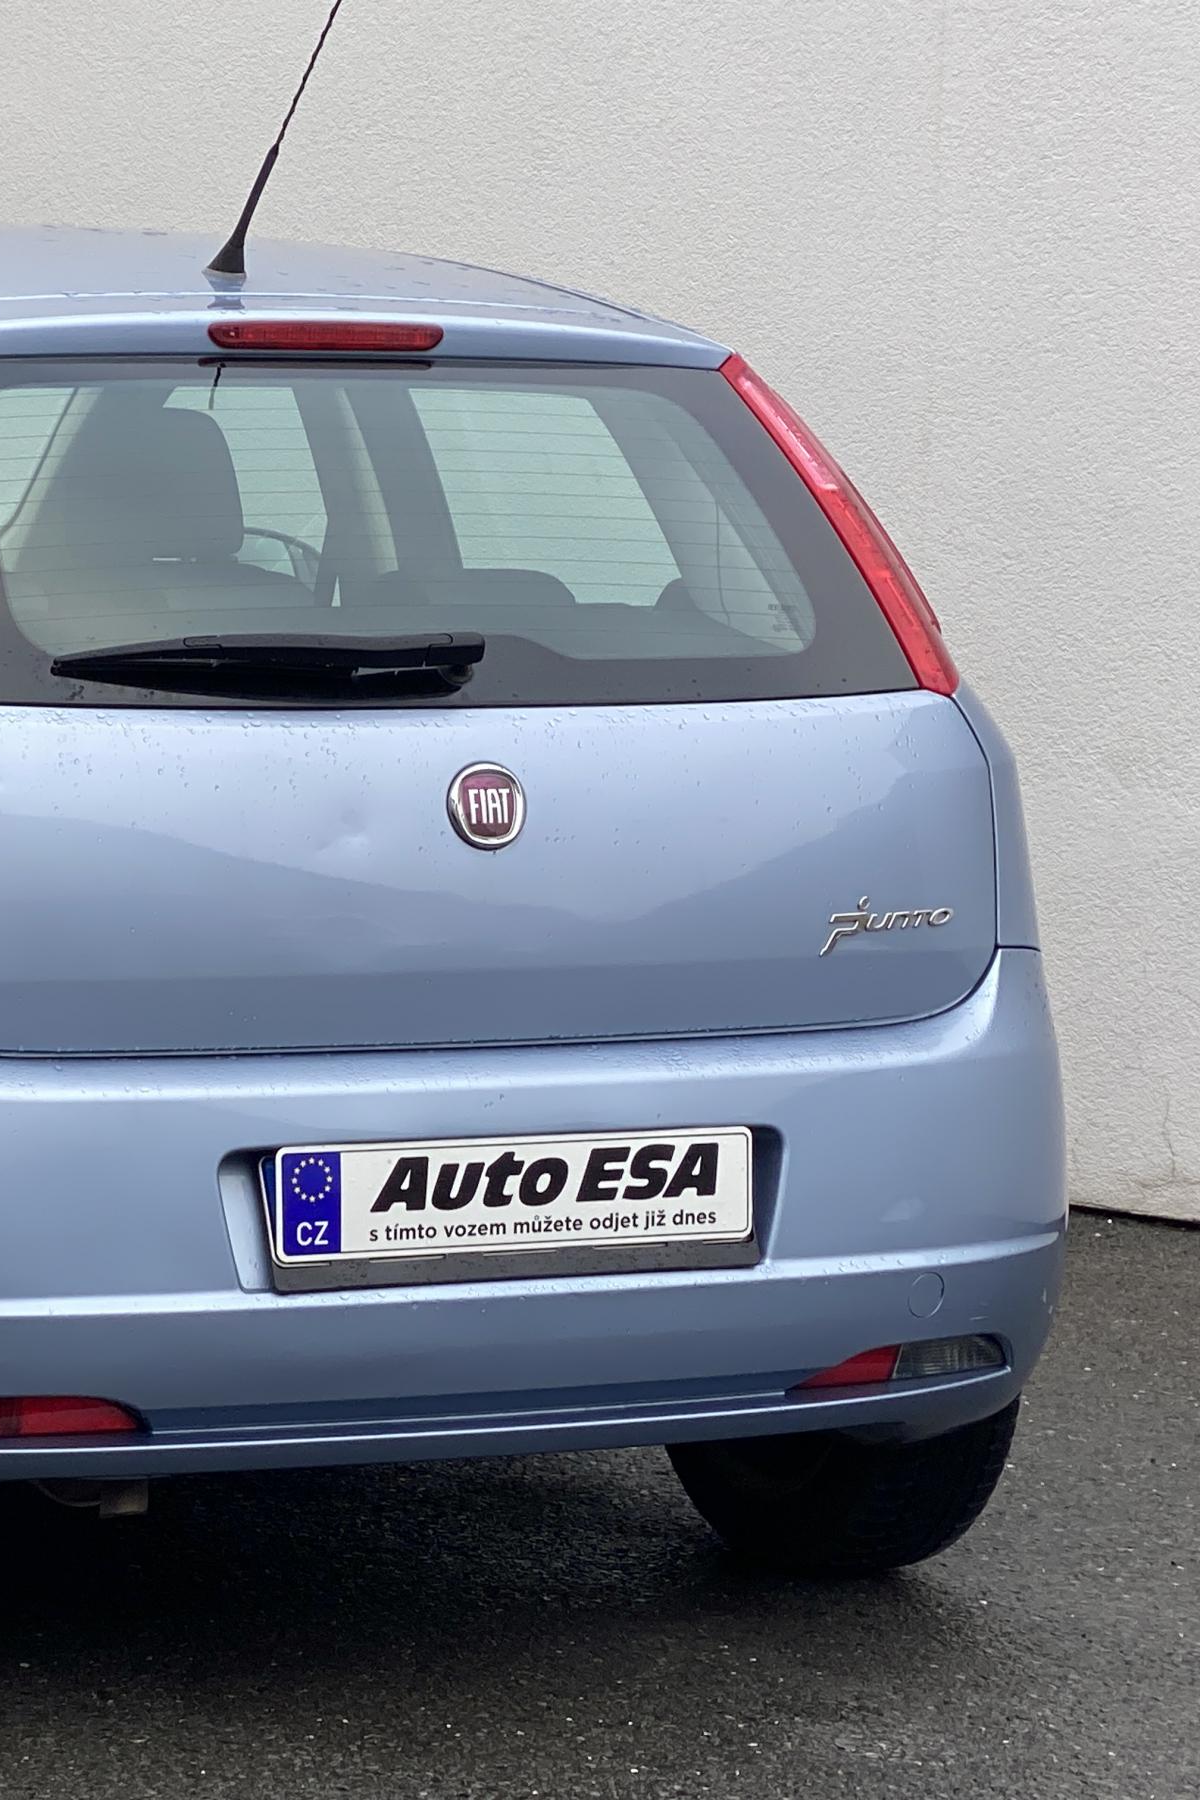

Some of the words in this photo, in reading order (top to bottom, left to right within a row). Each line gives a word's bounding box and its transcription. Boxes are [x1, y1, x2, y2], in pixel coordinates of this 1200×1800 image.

[468, 788, 510, 824] FIAT
[370, 1151, 568, 1213] Auto
[576, 1142, 720, 1202] ESA
[296, 1221, 330, 1246] CZ
[369, 1229, 379, 1242] s
[385, 1223, 438, 1241] tímto
[444, 1222, 507, 1238] vozem
[513, 1215, 583, 1235] můžete
[589, 1212, 639, 1232] odjet
[644, 1209, 667, 1230] již
[672, 1209, 718, 1226] dnes
